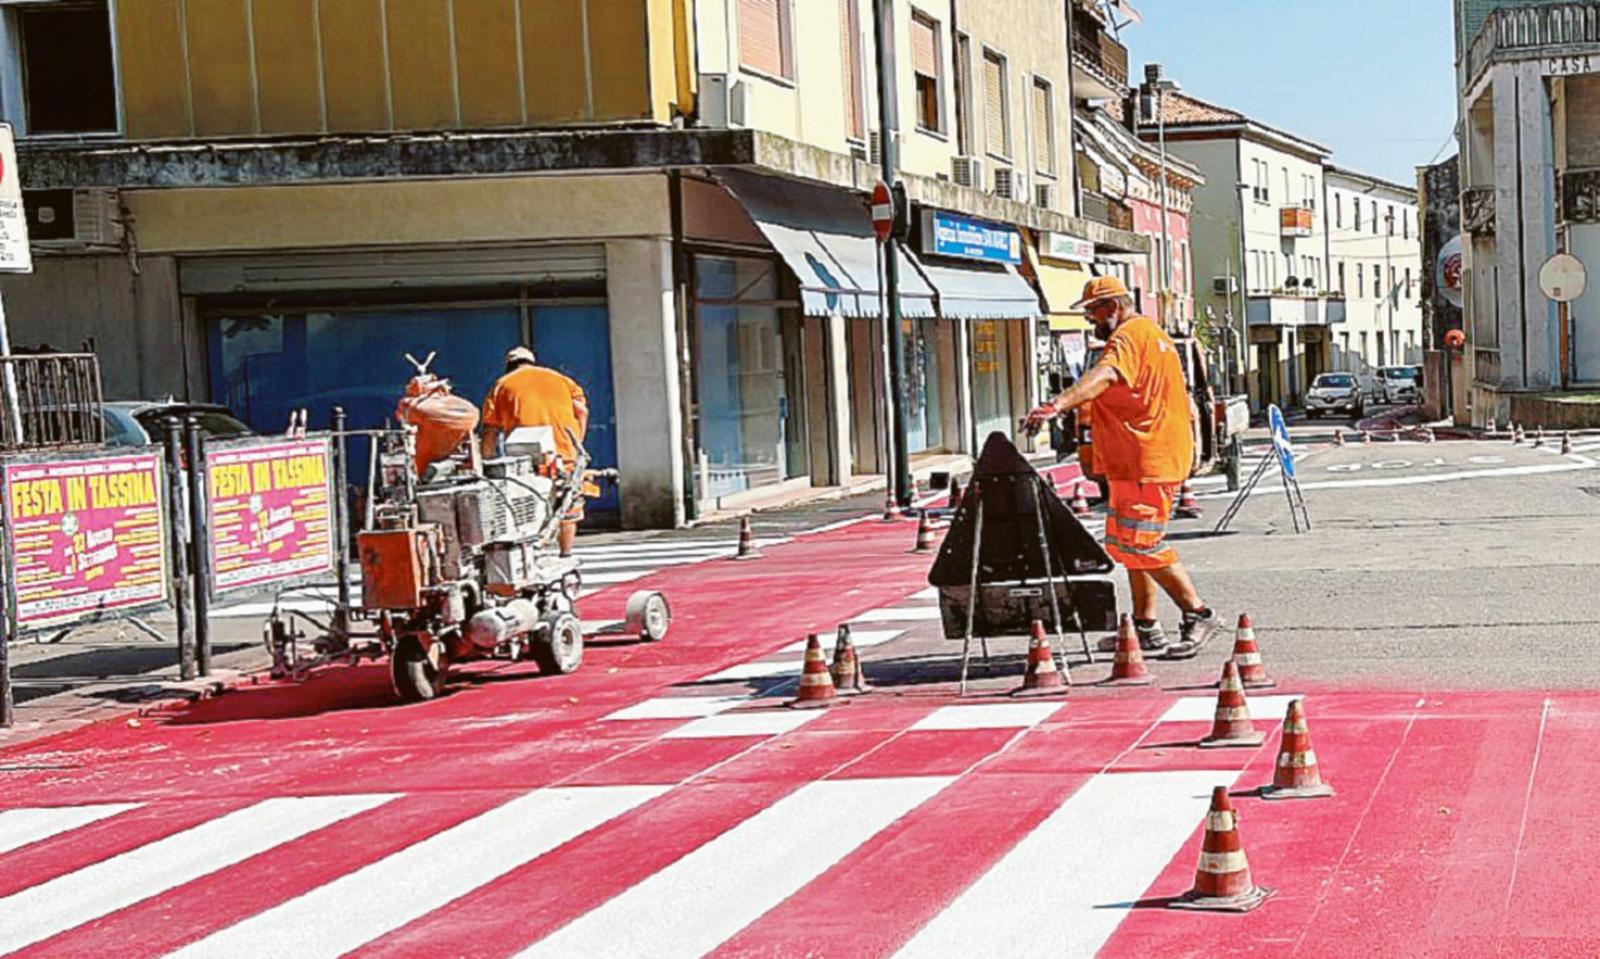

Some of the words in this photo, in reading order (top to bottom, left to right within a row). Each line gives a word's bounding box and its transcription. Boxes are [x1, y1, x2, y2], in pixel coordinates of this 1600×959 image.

[1548, 56, 1592, 74] CASA
[11, 479, 63, 519] FESTA
[66, 476, 87, 511] IN
[88, 471, 156, 509] TASSINA
[210, 463, 252, 498] FESTA
[253, 461, 271, 493] IN
[272, 454, 326, 490] TASSINA
